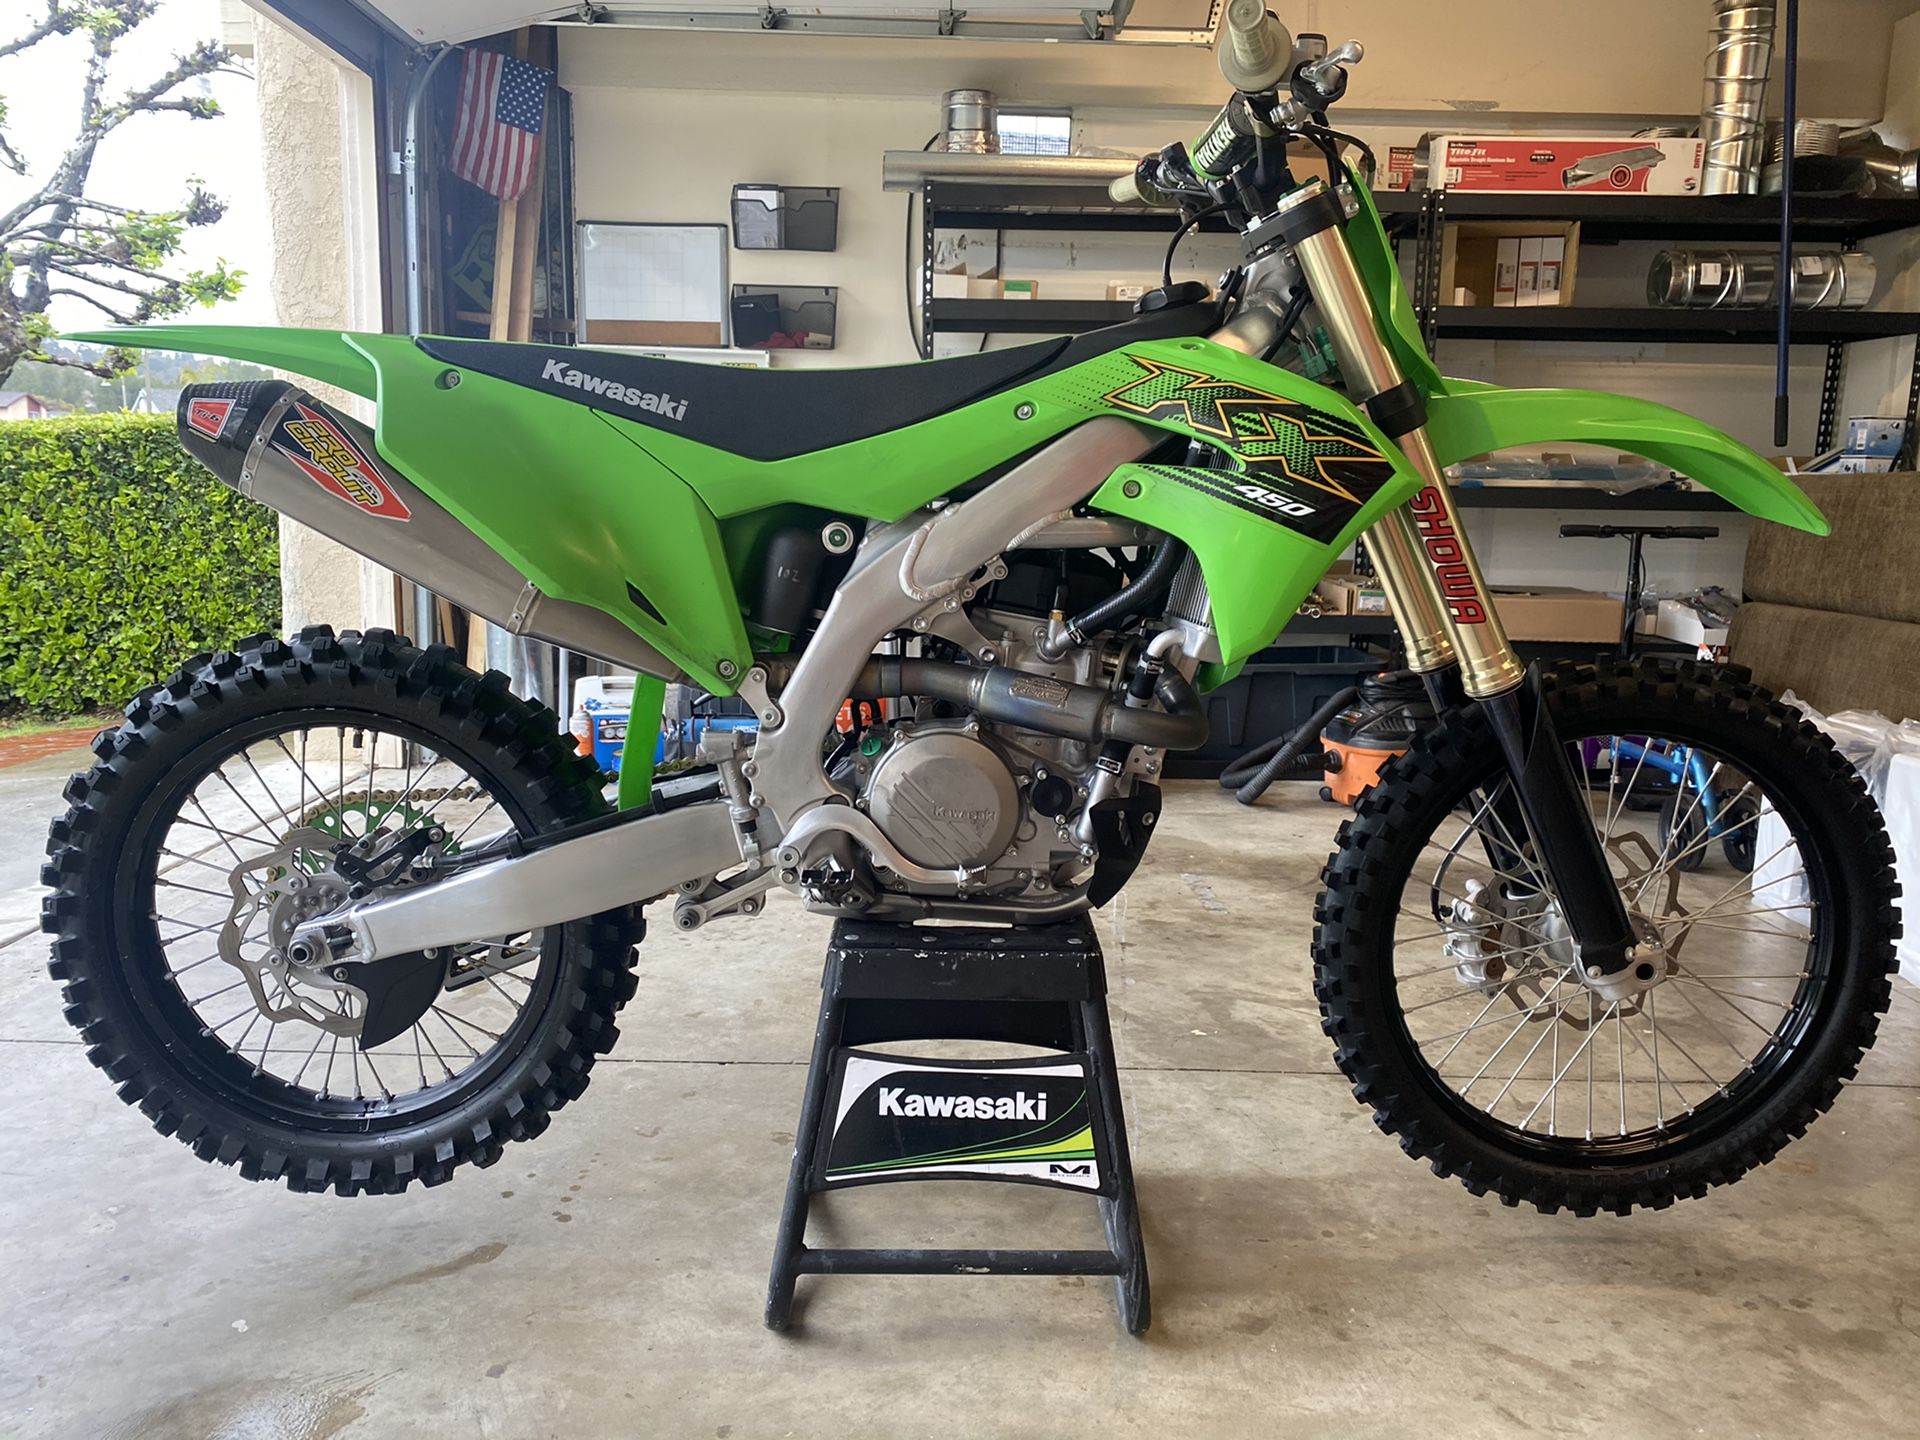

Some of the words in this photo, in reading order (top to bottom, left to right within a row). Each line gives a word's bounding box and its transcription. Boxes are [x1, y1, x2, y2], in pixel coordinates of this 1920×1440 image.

[541, 358, 689, 422] Kawasaki
[286, 422, 377, 506] CIRCUIT
[305, 420, 358, 468] PRO
[1233, 484, 1316, 517] 450
[1409, 486, 1487, 624] SHOWA
[878, 1087, 1047, 1121] Kawasaki
